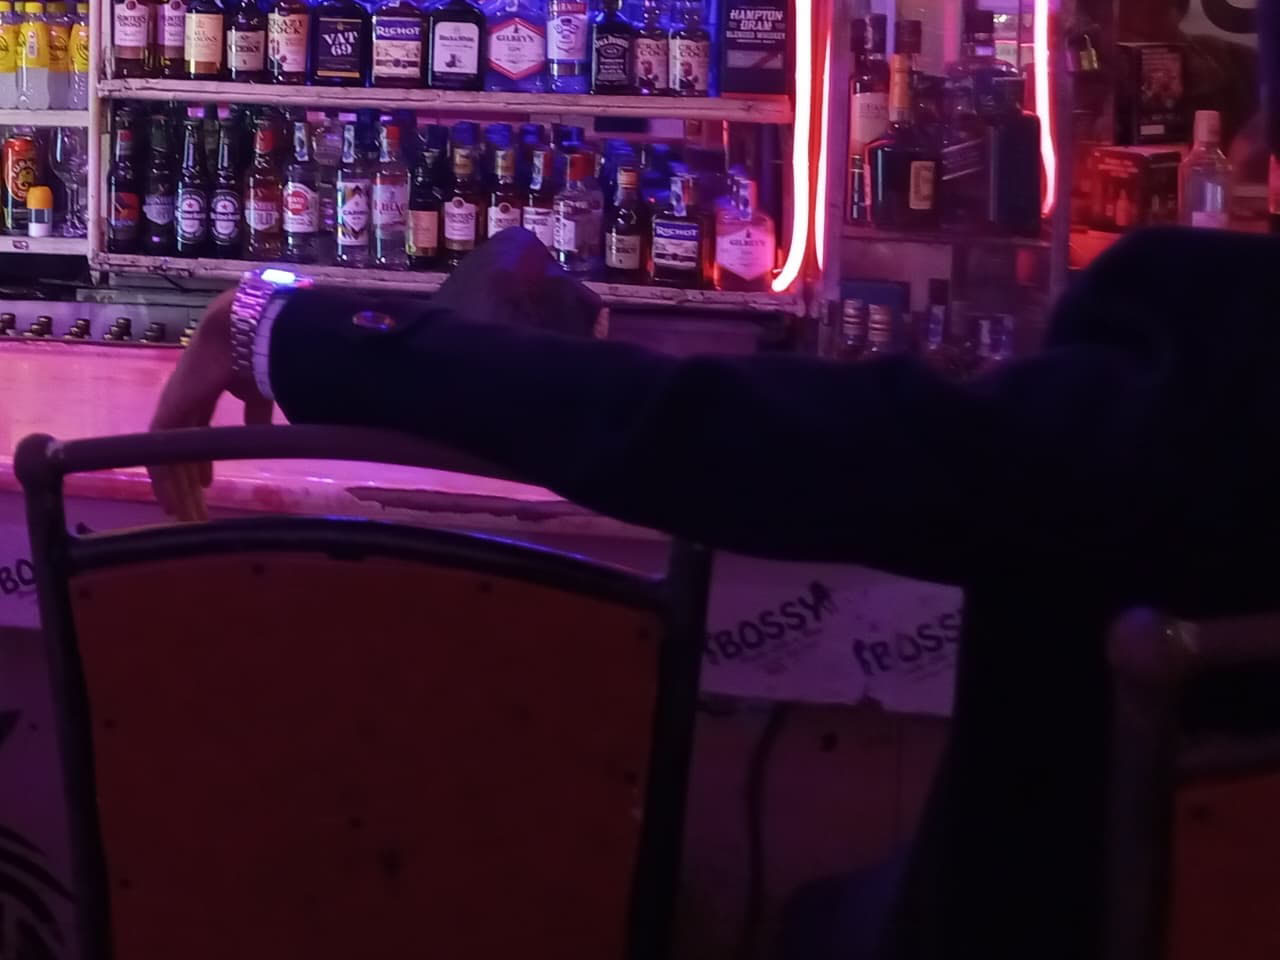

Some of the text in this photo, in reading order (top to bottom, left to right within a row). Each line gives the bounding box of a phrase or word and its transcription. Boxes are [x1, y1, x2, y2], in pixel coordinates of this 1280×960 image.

[730, 9, 784, 21] HAMPTON
[322, 31, 358, 45] VAT
[330, 43, 353, 57] 69
[714, 585, 833, 661] BOSSY
